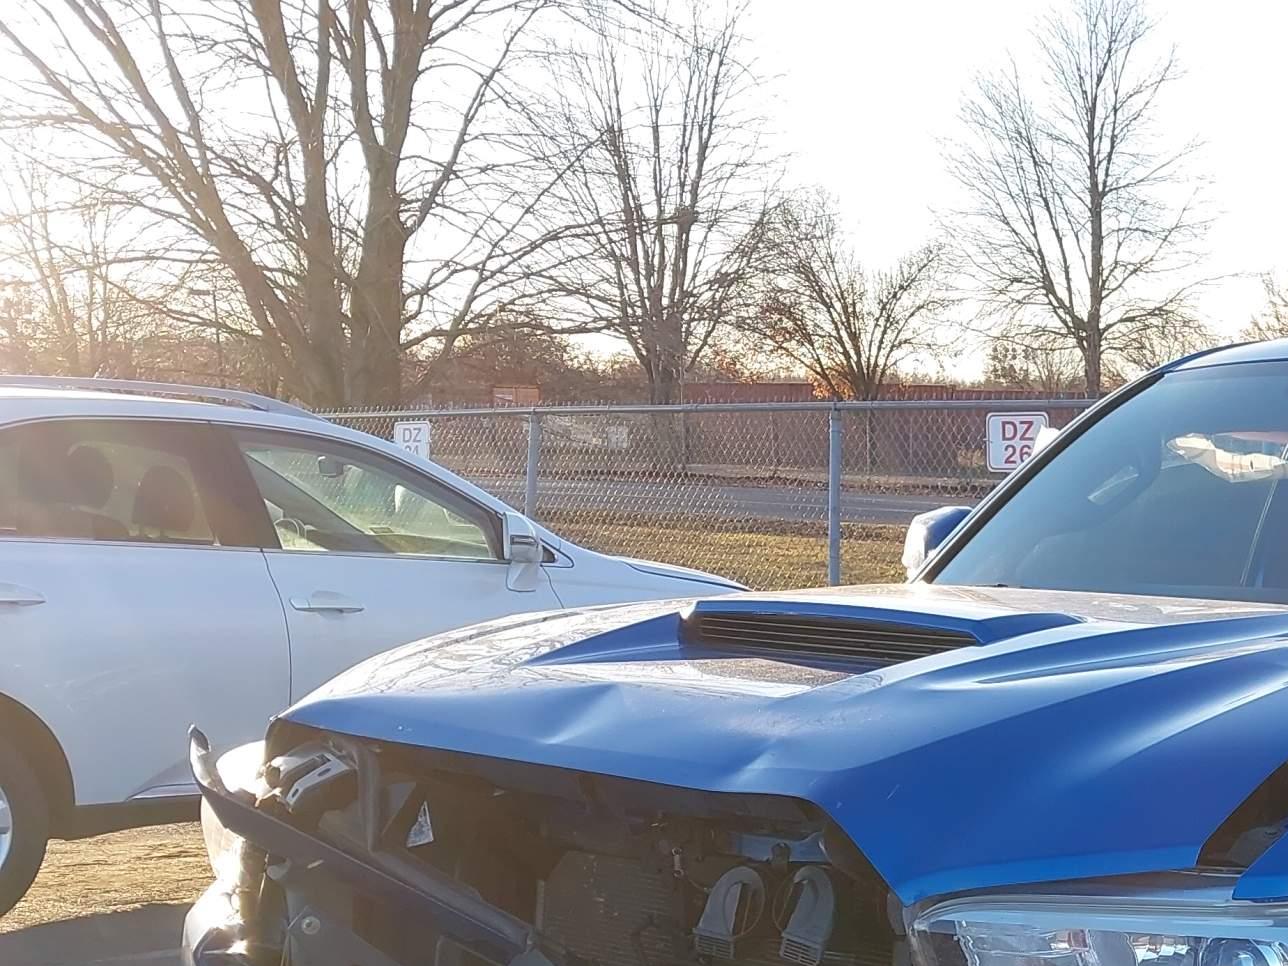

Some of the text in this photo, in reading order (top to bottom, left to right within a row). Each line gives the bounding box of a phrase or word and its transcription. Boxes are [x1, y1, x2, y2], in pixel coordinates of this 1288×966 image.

[402, 427, 422, 443] DZ
[1001, 420, 1034, 442] DZ
[1004, 444, 1033, 465] 26
